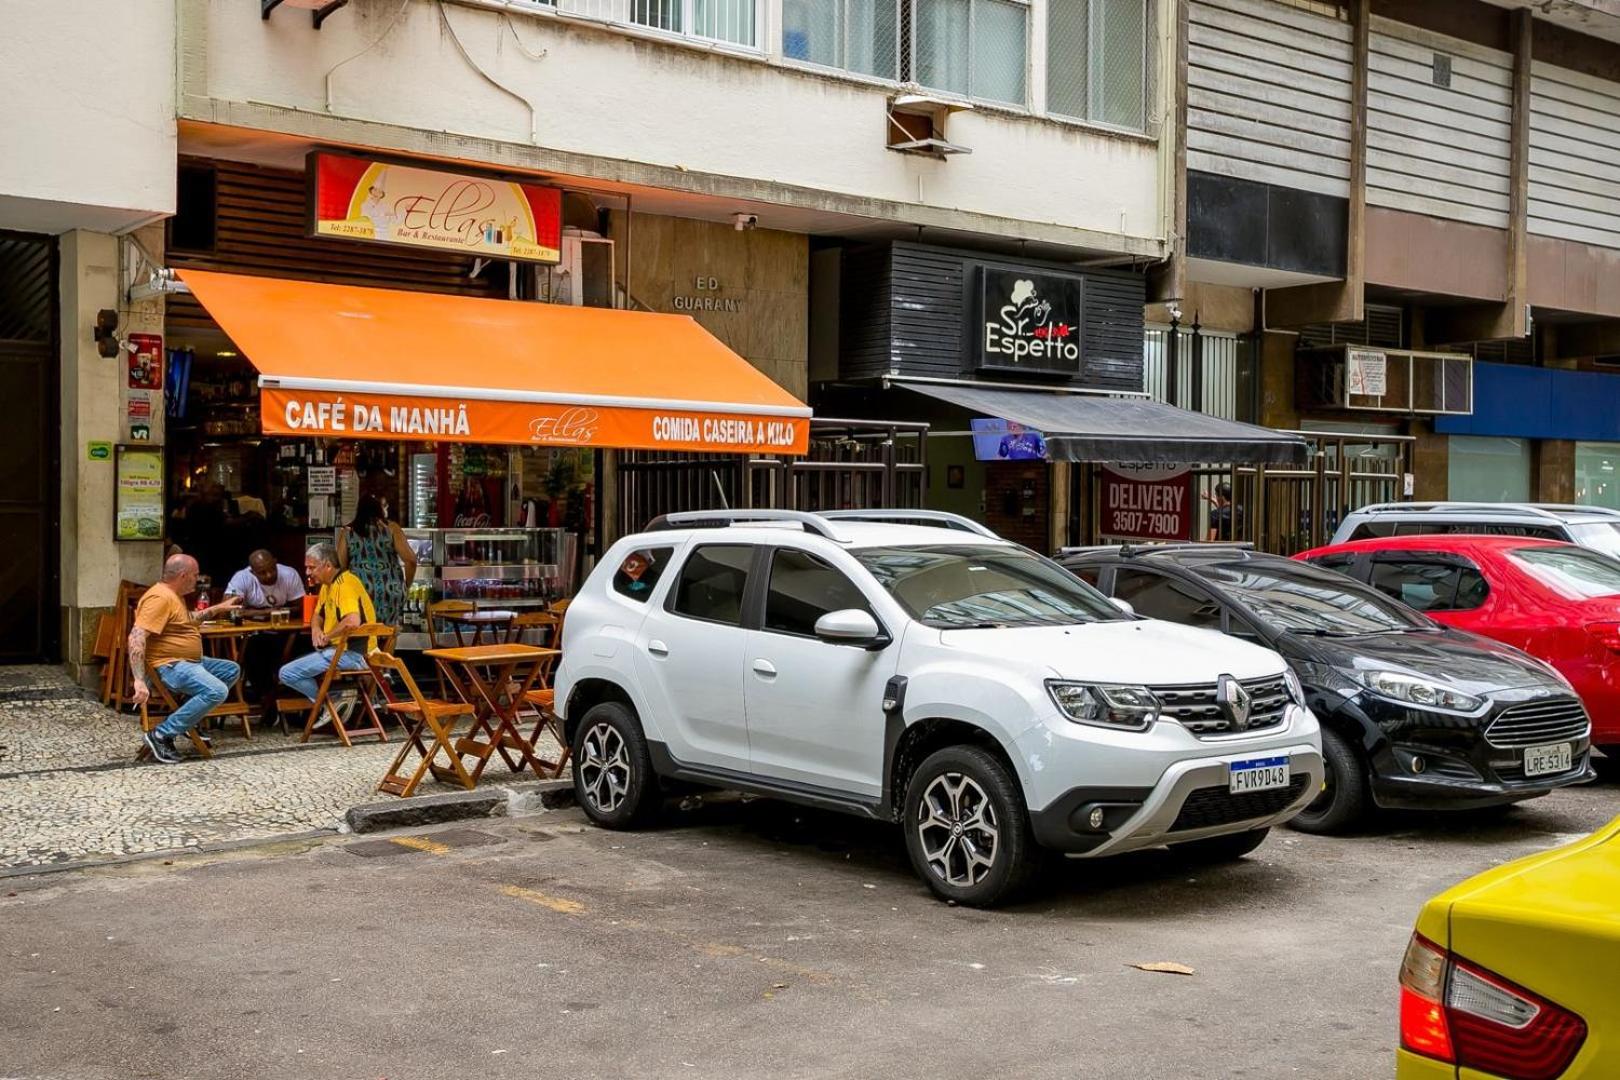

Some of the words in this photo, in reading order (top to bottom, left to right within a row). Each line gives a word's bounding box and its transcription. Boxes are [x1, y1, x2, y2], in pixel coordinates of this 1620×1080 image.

[394, 179, 496, 247] Ellas
[397, 228, 411, 237] Bar
[413, 231, 419, 239] &
[421, 231, 466, 245] Restaurante
[696, 276, 718, 290] ED
[674, 296, 743, 312] GUARANY
[985, 321, 1078, 362] Espetto
[285, 397, 346, 431] CAFÉ
[353, 404, 384, 432] DA
[390, 403, 470, 435] MANHÃ
[529, 407, 600, 443] Ellas
[652, 416, 701, 442] COMIDA
[703, 418, 754, 444] CASEIRA
[756, 421, 765, 444] A
[767, 421, 794, 446] KILO
[1109, 483, 1185, 512] DELIVERY
[1113, 511, 1180, 535] 3507-7900
[1236, 767, 1284, 790] FVR9D48
